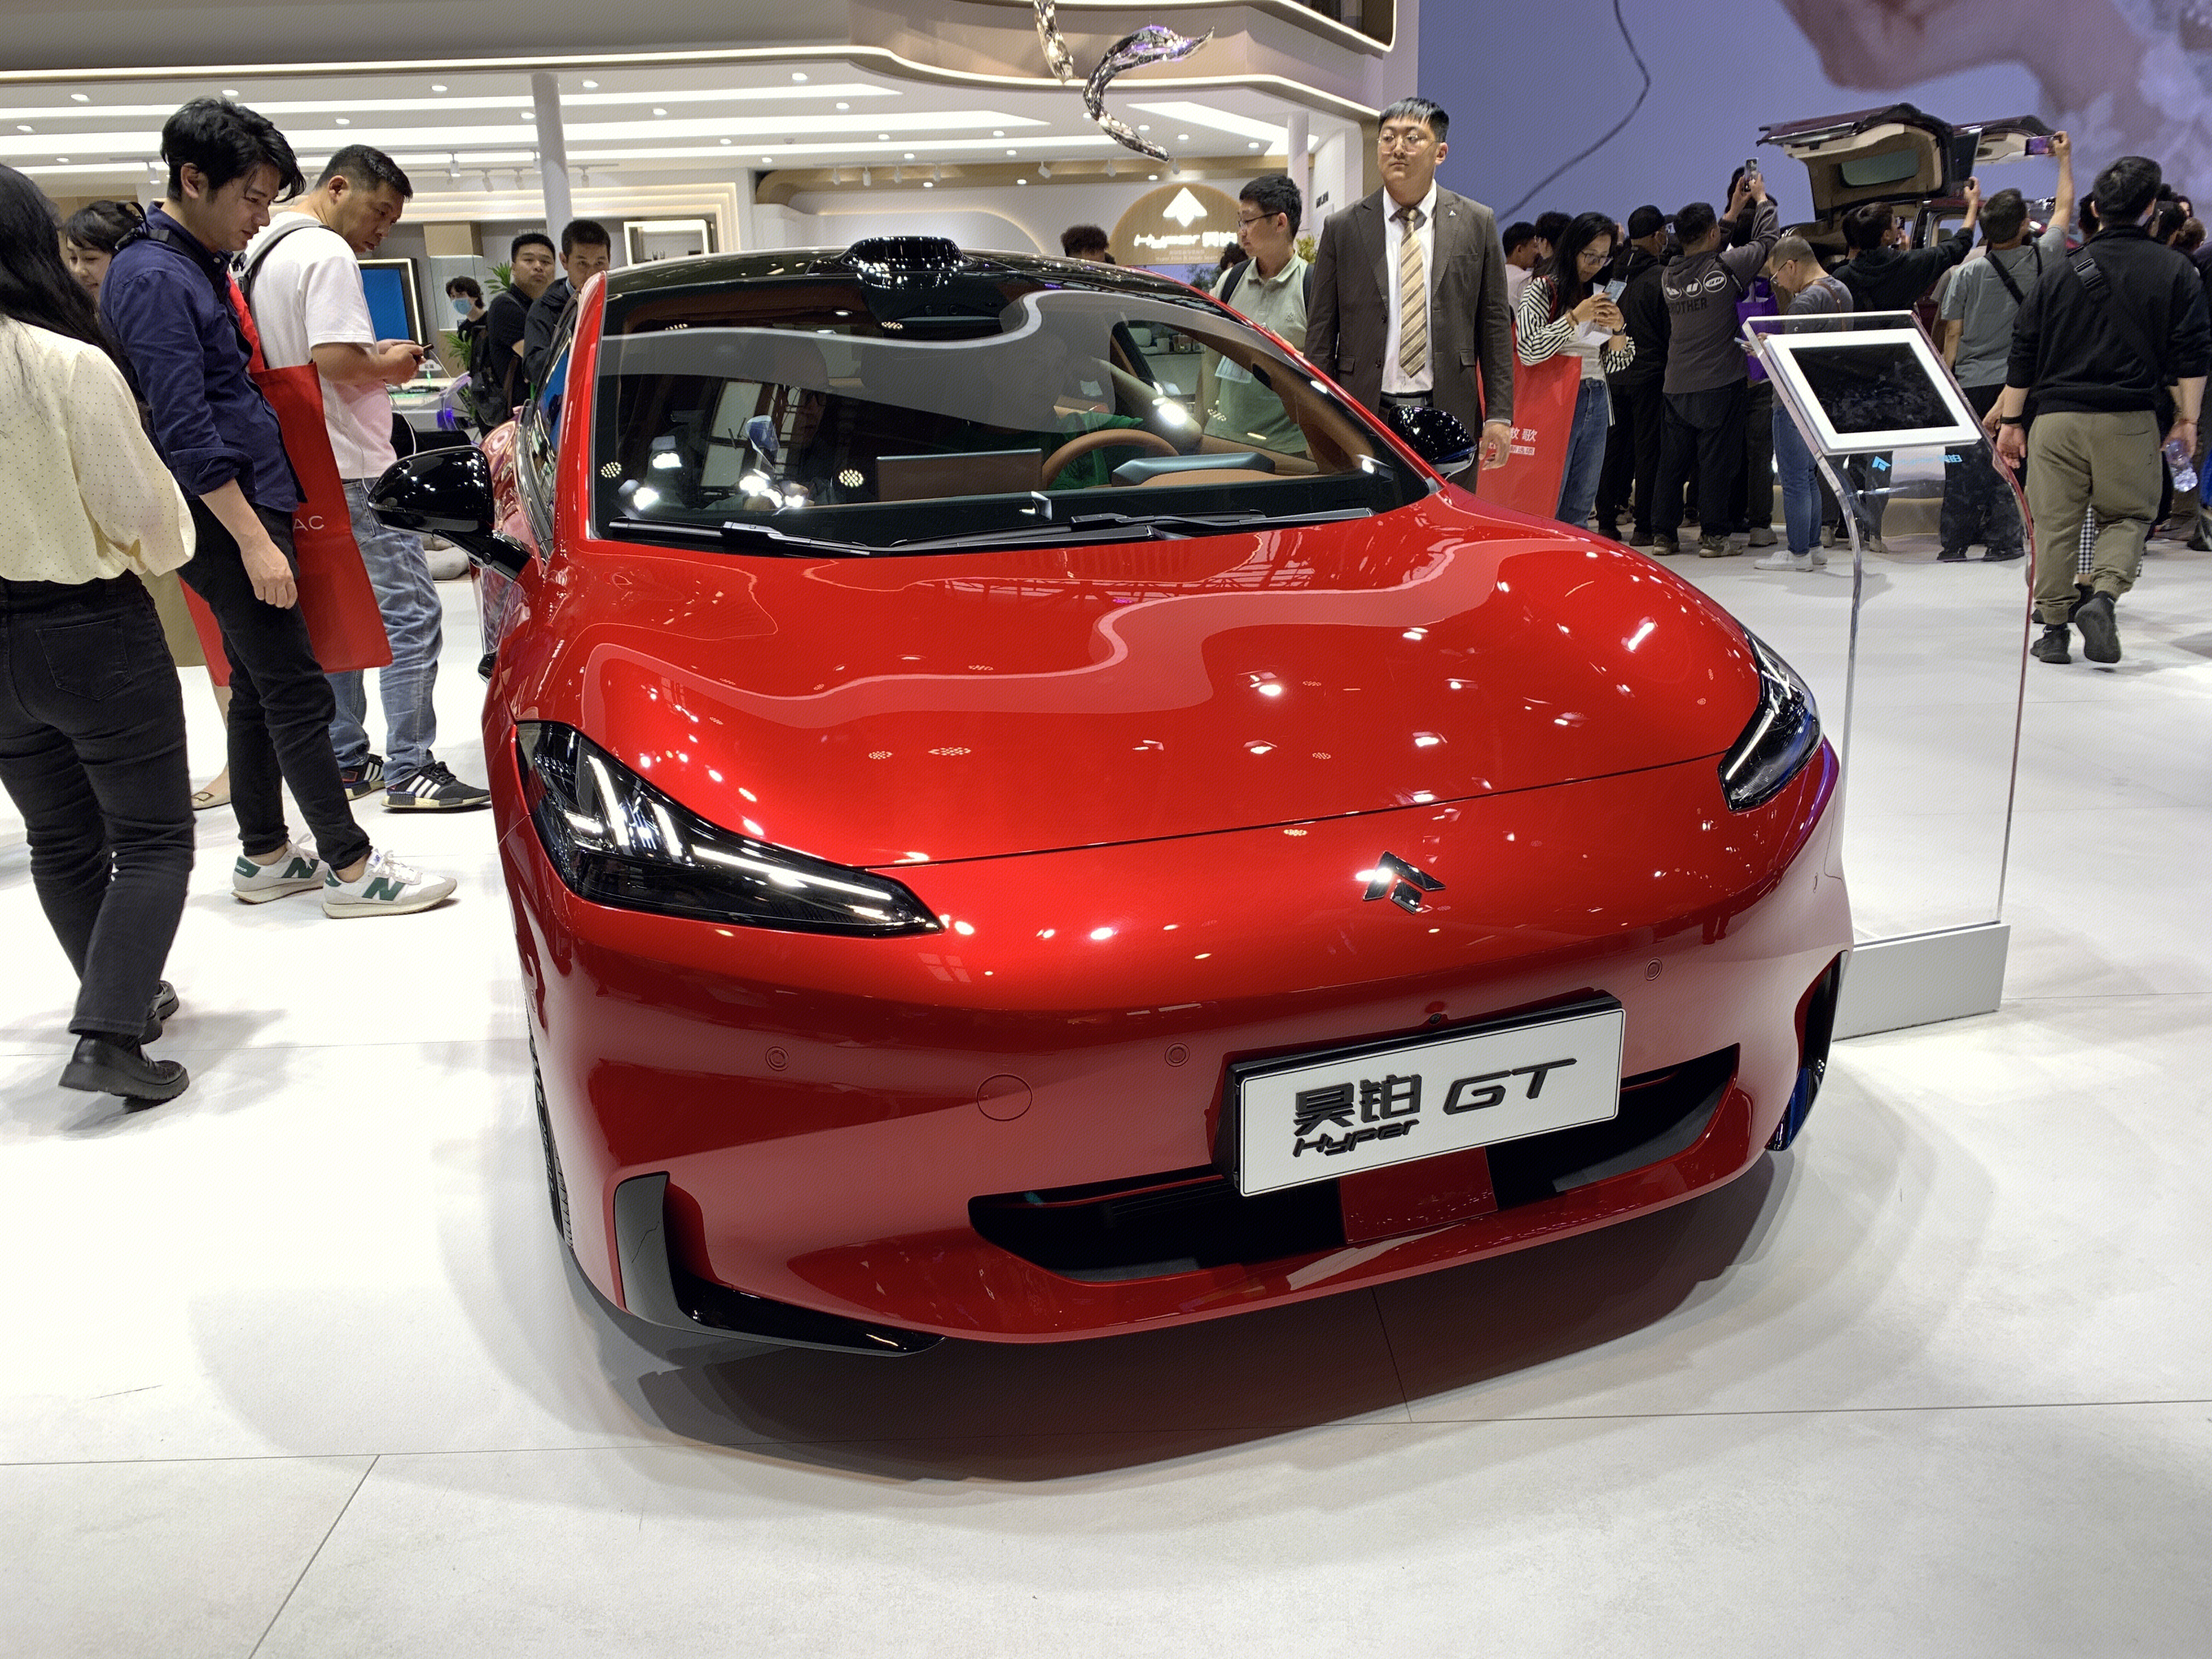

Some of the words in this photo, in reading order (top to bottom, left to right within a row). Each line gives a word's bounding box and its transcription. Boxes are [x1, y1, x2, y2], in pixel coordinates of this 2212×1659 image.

[1295, 1074, 1422, 1136] 昊铂
[1443, 1058, 1577, 1115] GT
[1293, 1119, 1420, 1158] Hyper
